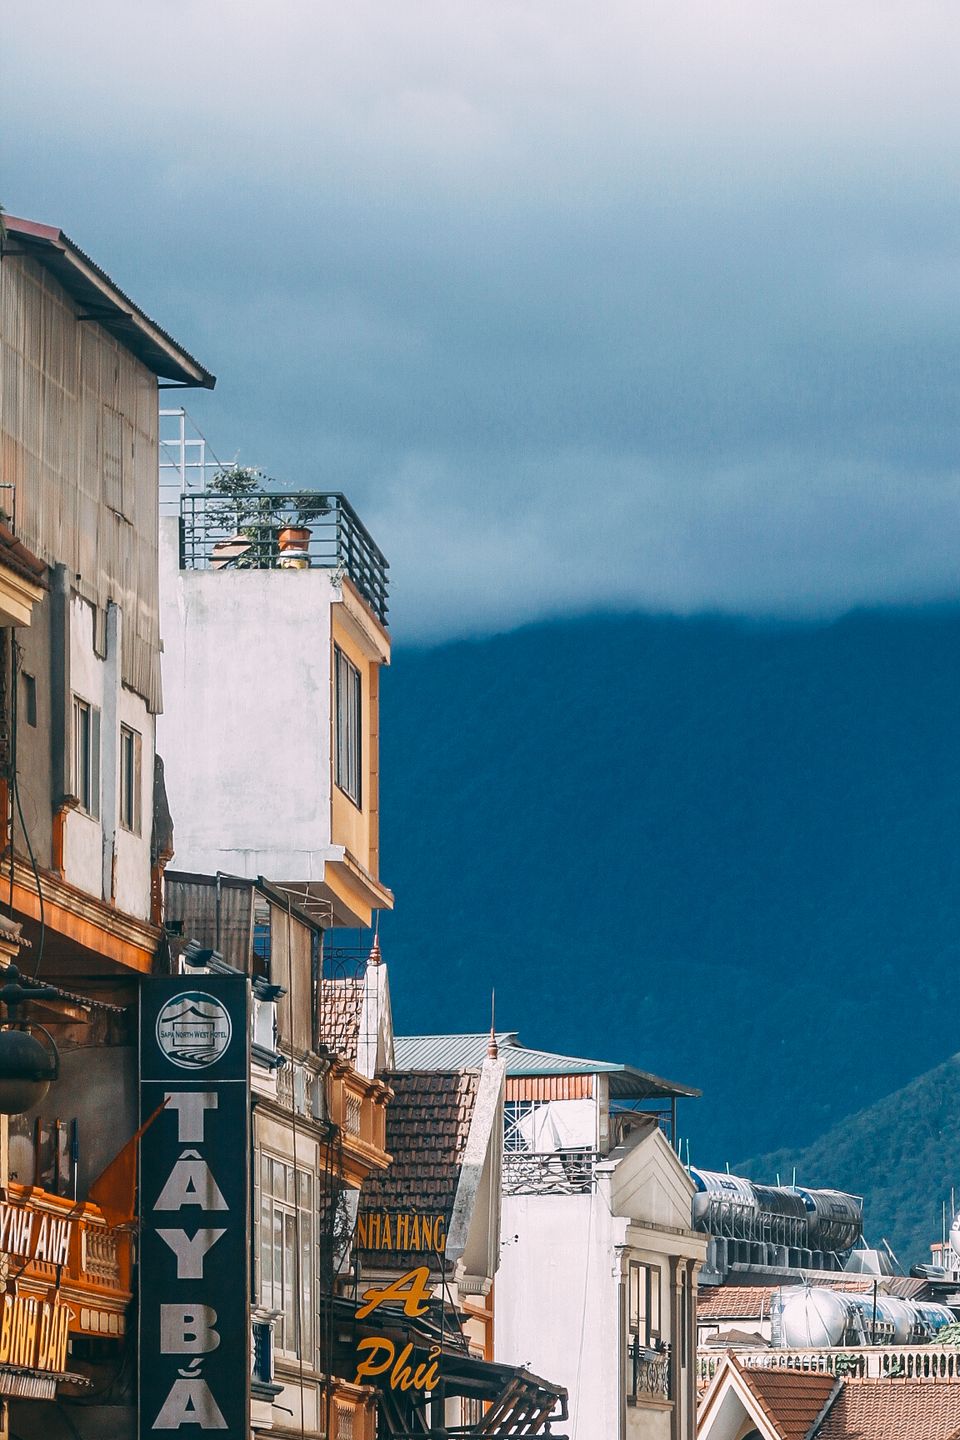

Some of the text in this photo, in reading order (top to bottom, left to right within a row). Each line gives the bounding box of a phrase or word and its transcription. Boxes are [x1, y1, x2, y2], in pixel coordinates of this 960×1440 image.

[35, 1215, 72, 1266] ANH
[358, 1207, 446, 1252] NHÀ HÀNG
